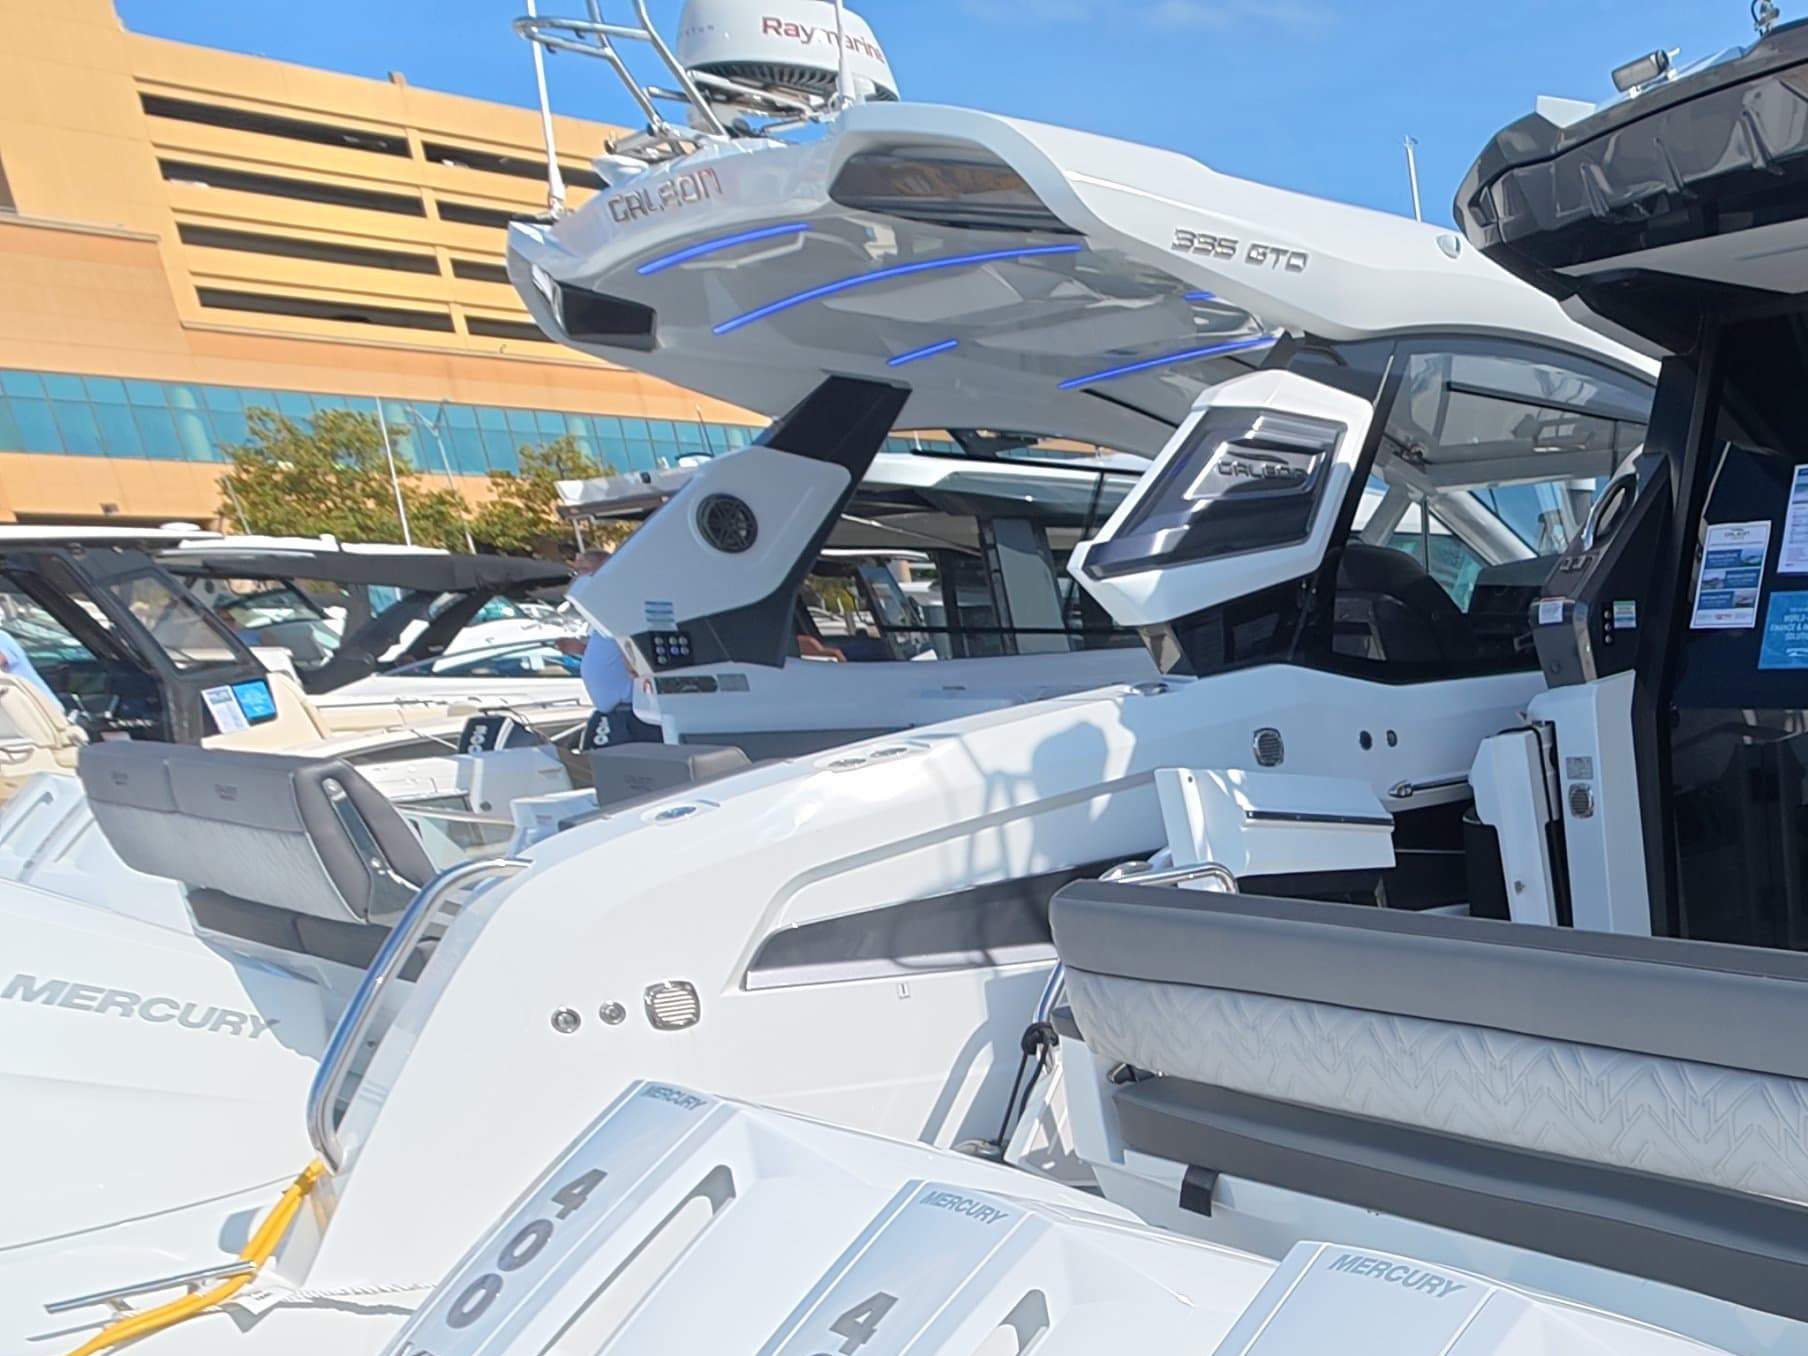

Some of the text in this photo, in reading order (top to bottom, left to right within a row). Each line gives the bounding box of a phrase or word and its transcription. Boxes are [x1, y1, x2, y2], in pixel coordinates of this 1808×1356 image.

[761, 16, 886, 63] Raymarine
[607, 168, 723, 223] GALEON
[1171, 228, 1309, 272] 335 GTO
[0, 973, 280, 1039] MERCURY
[639, 1085, 707, 1111] MERCURY
[920, 1191, 1008, 1225] MERCURY
[446, 1168, 607, 1329] 400
[1328, 1254, 1468, 1298] MERCURY
